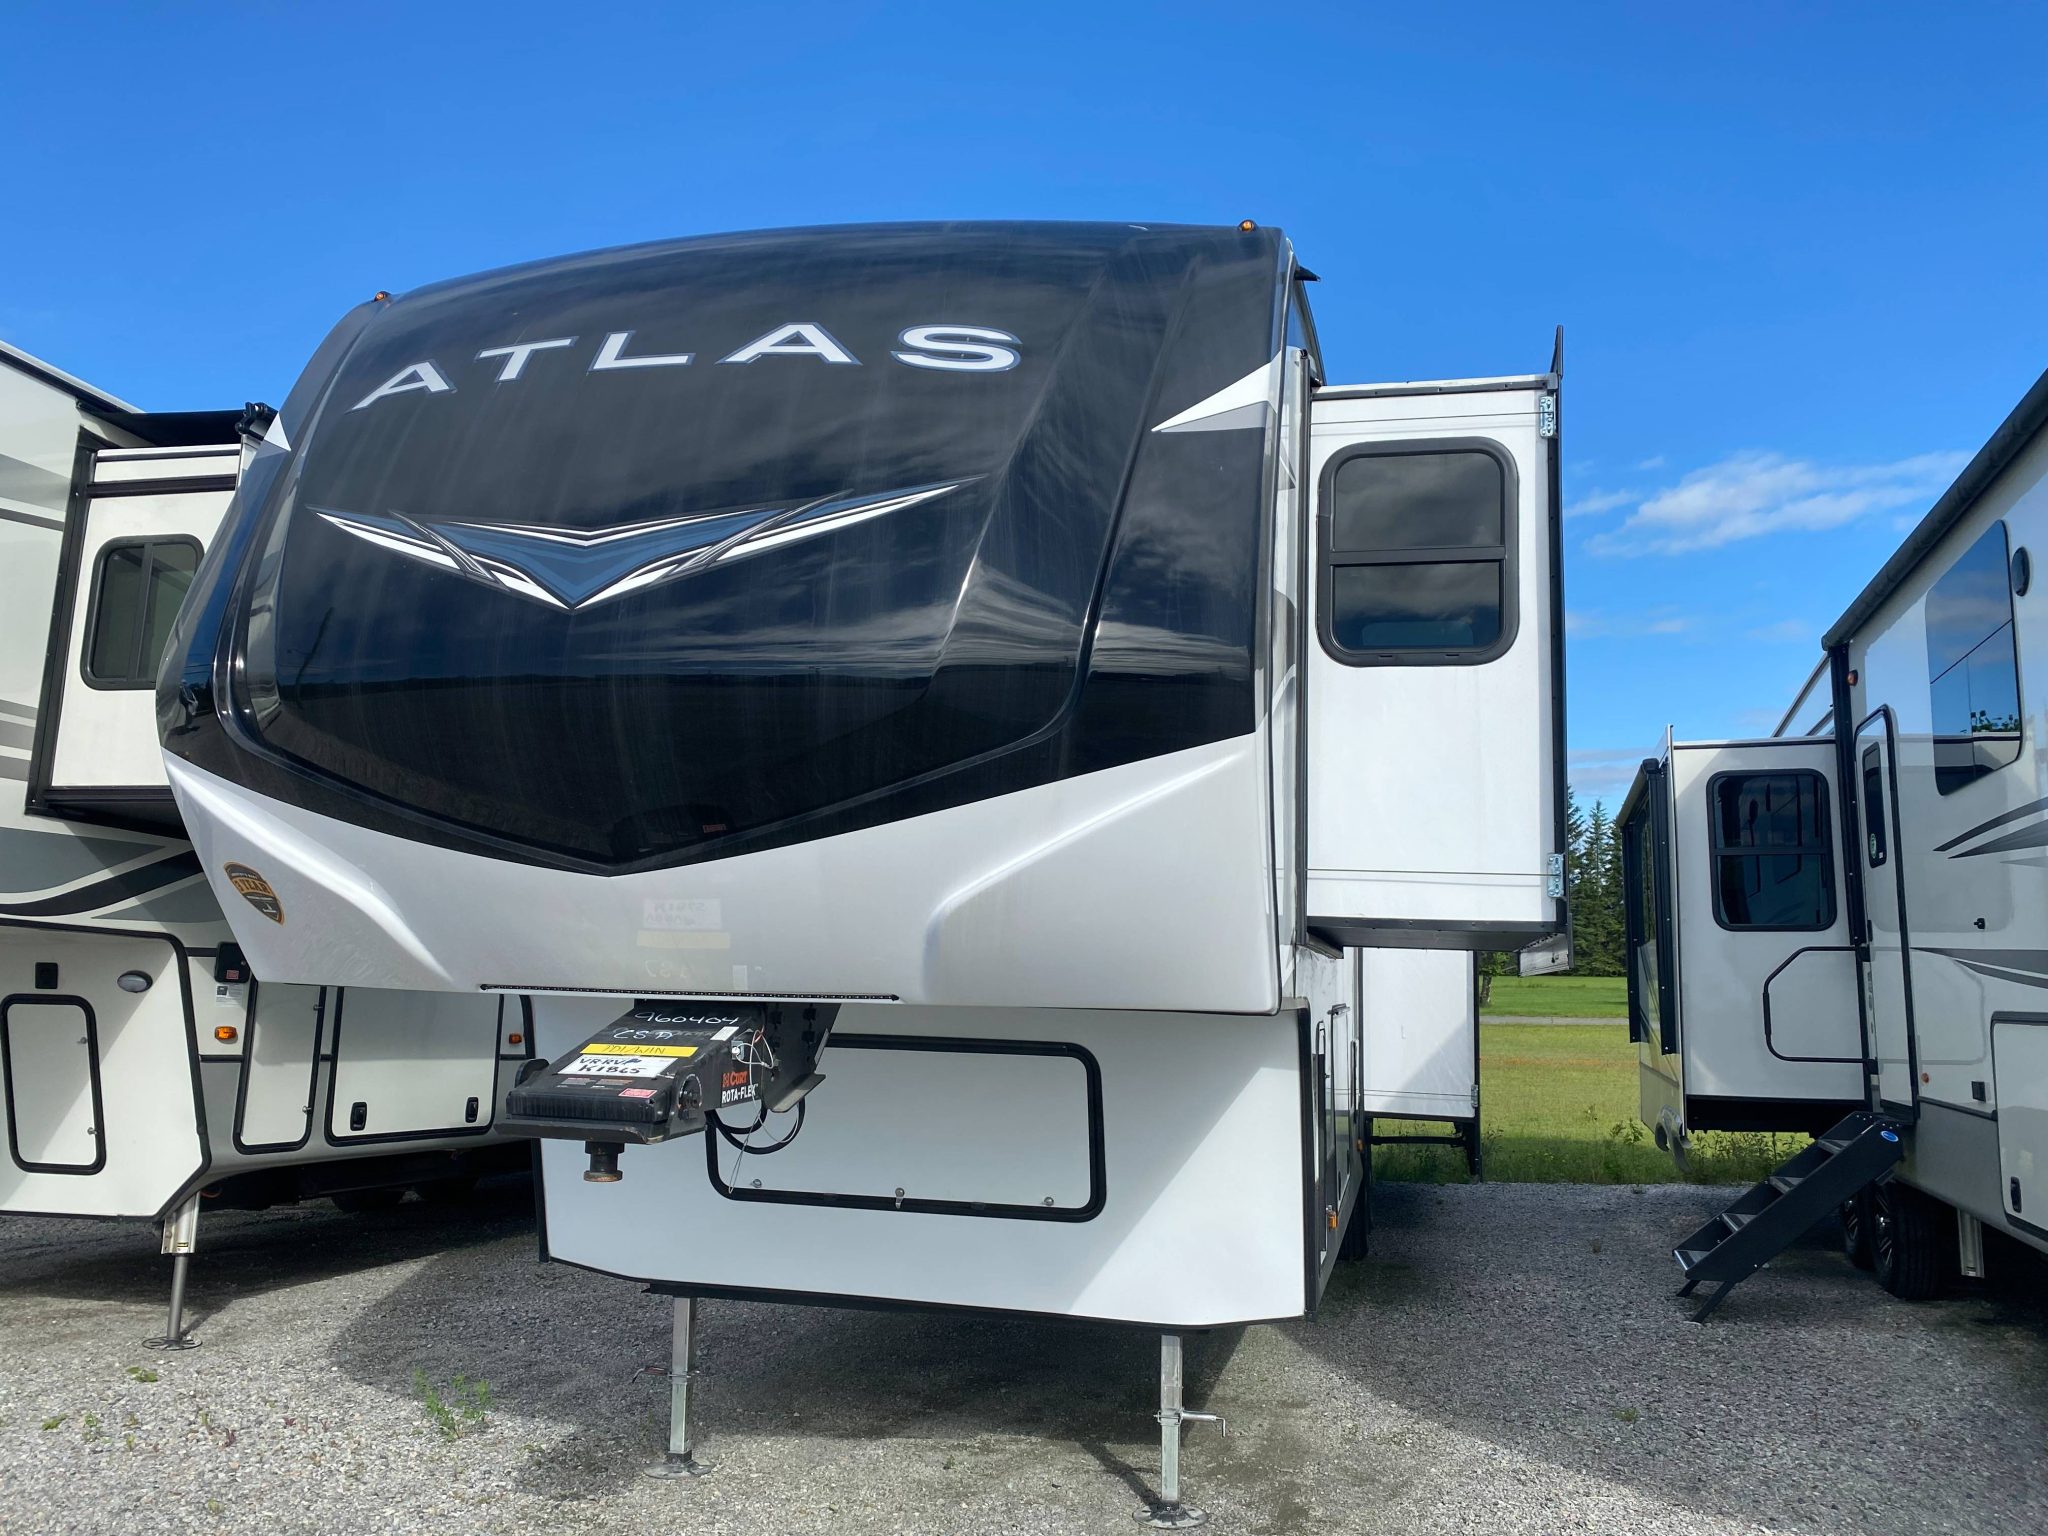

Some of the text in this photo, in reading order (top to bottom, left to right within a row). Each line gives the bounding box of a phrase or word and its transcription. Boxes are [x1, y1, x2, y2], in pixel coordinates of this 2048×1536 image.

[346, 322, 1022, 413] ATLAS
[634, 1011, 740, 1025] 960404
[730, 1071, 748, 1086] CURT
[721, 1084, 756, 1104] ROTA-FLEX
